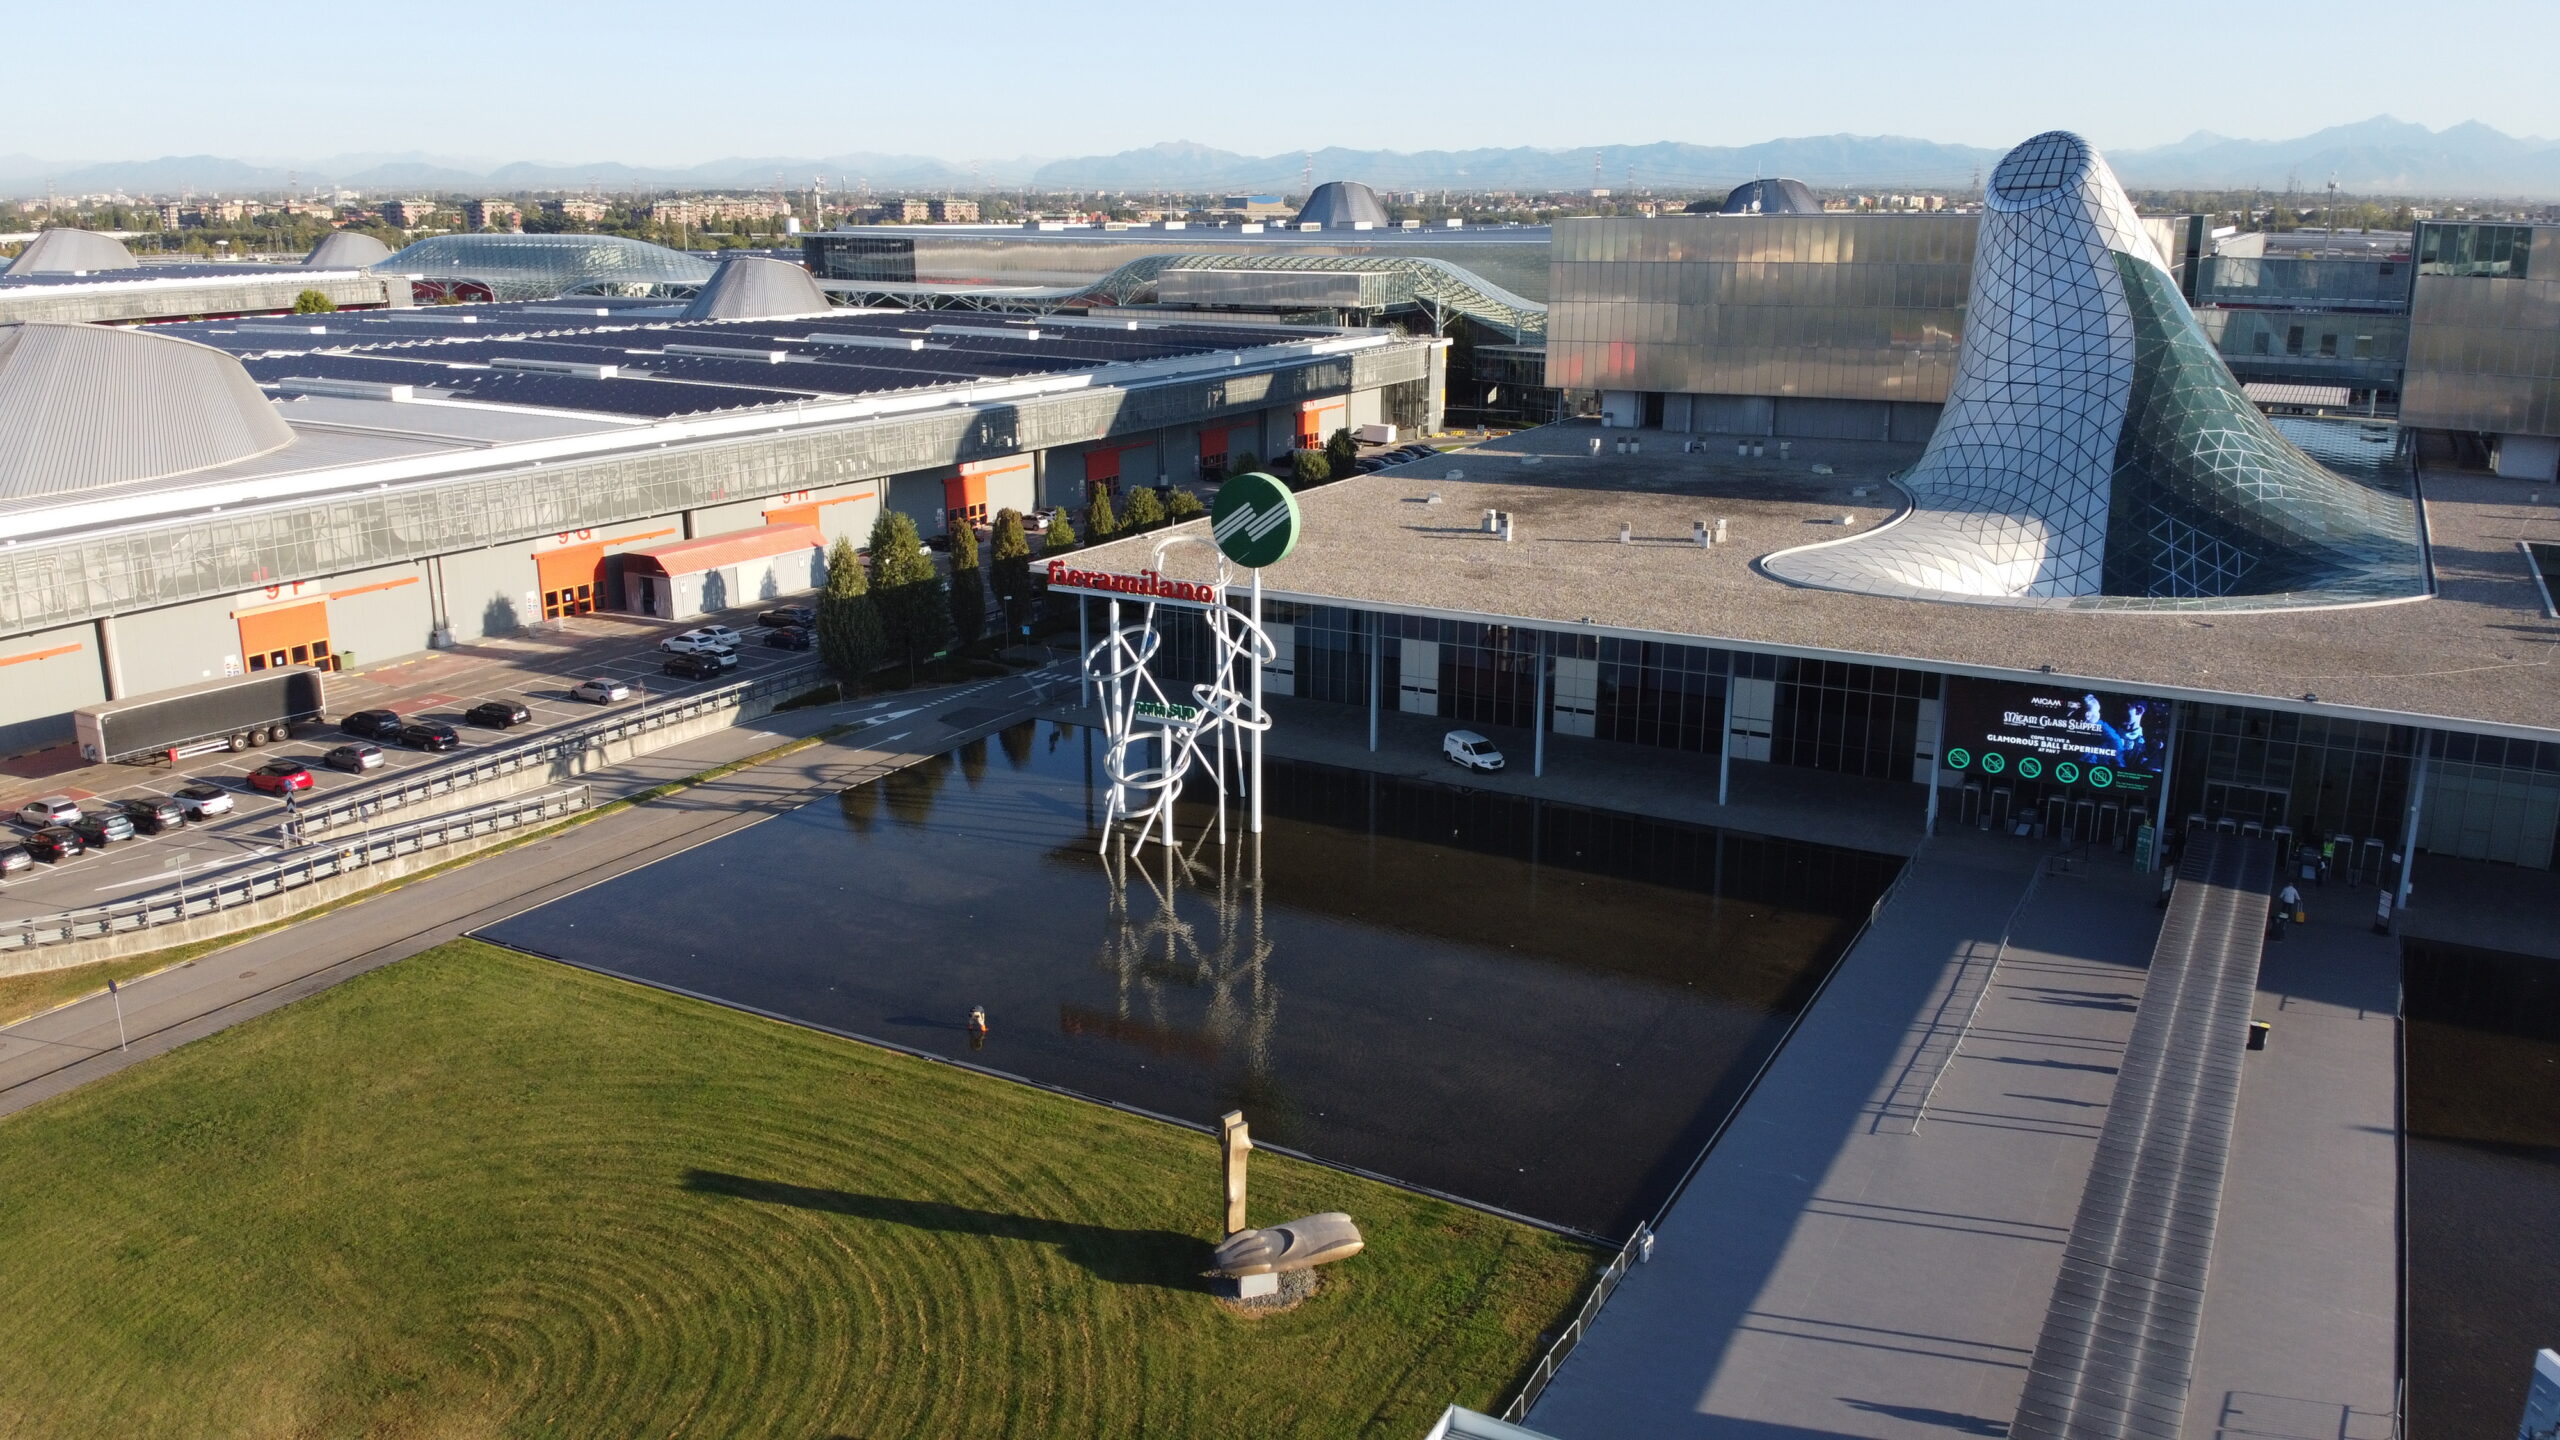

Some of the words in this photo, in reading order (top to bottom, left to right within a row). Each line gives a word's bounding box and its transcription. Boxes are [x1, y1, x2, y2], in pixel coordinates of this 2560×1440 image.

[1047, 560, 1214, 603] fieramilano
[2031, 697, 2062, 707] MICAM
[1986, 734, 2039, 747] GLAMOROUS
[2040, 740, 2060, 750] BALL
[2062, 743, 2117, 757] EXPERIENCE
